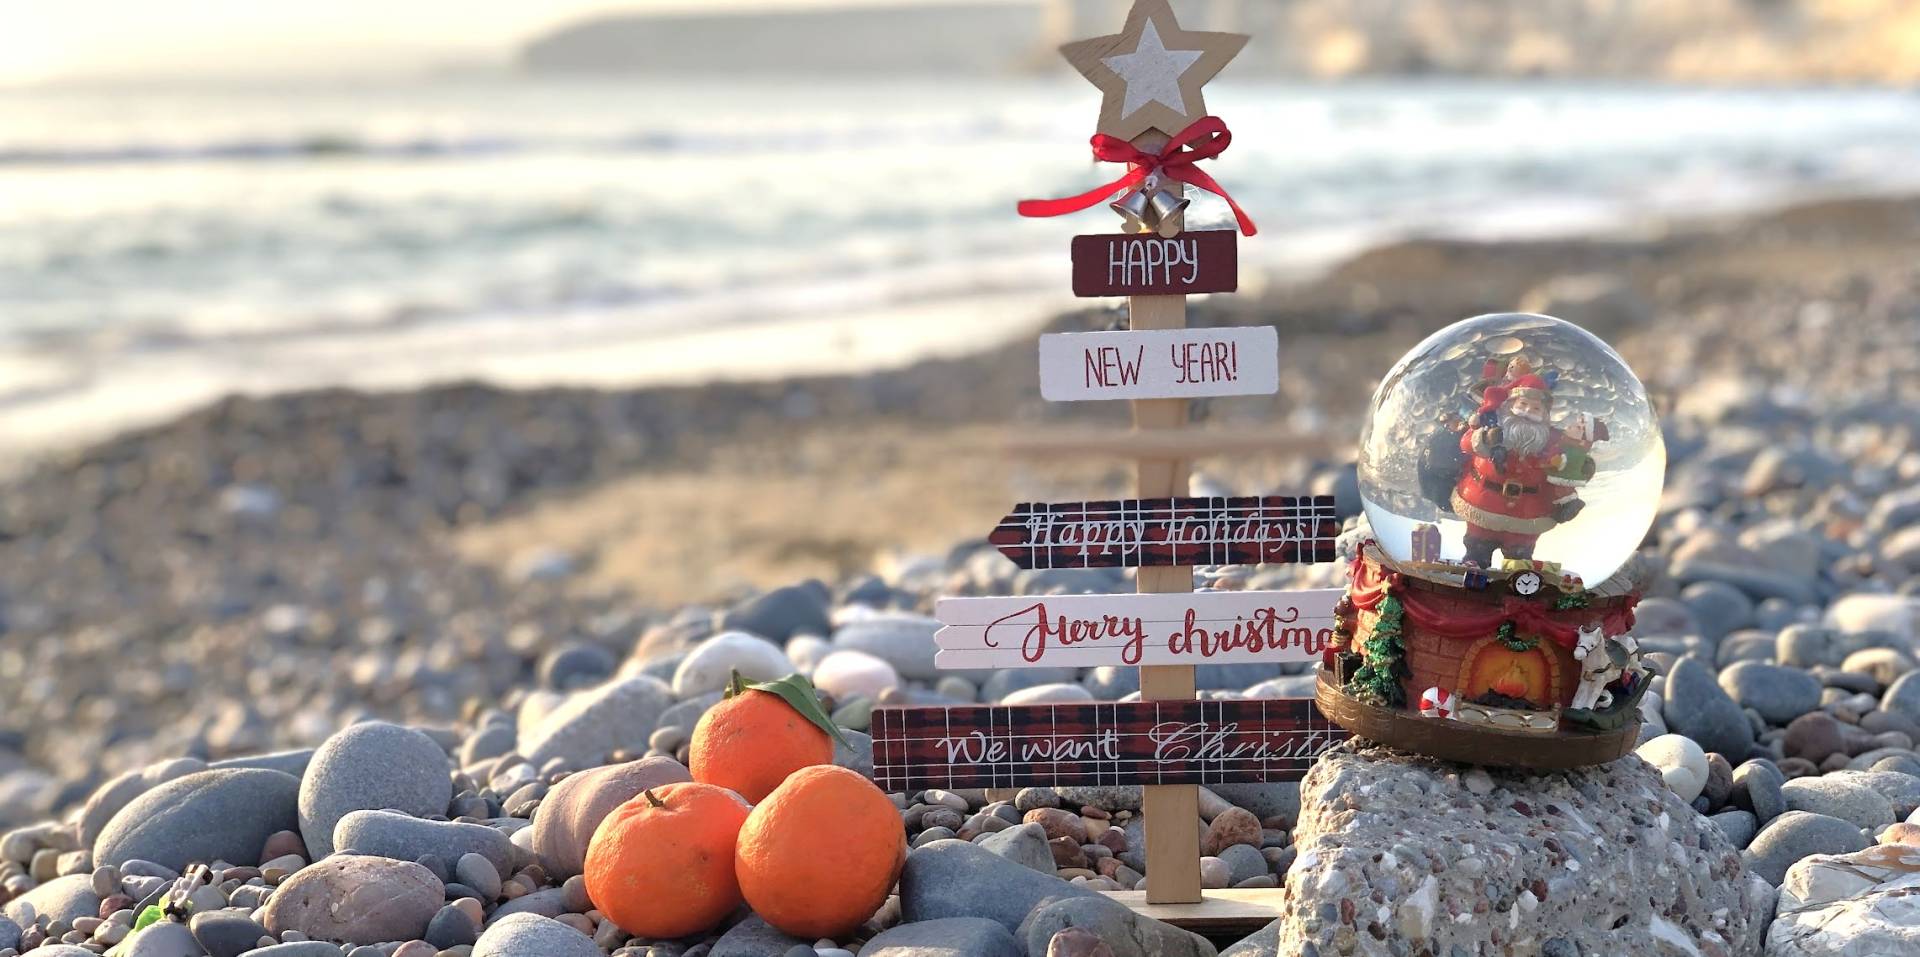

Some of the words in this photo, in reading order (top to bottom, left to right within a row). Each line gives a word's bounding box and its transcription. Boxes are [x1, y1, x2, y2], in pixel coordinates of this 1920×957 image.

[1109, 239, 1198, 286] HAPPY
[1084, 345, 1144, 388] NEW
[1171, 341, 1238, 384] YEAR!
[1022, 513, 1146, 555] Happy
[1159, 512, 1321, 553] Holidays!
[984, 602, 1149, 665] Merry
[935, 729, 1008, 764] We
[1020, 728, 1121, 763] want
